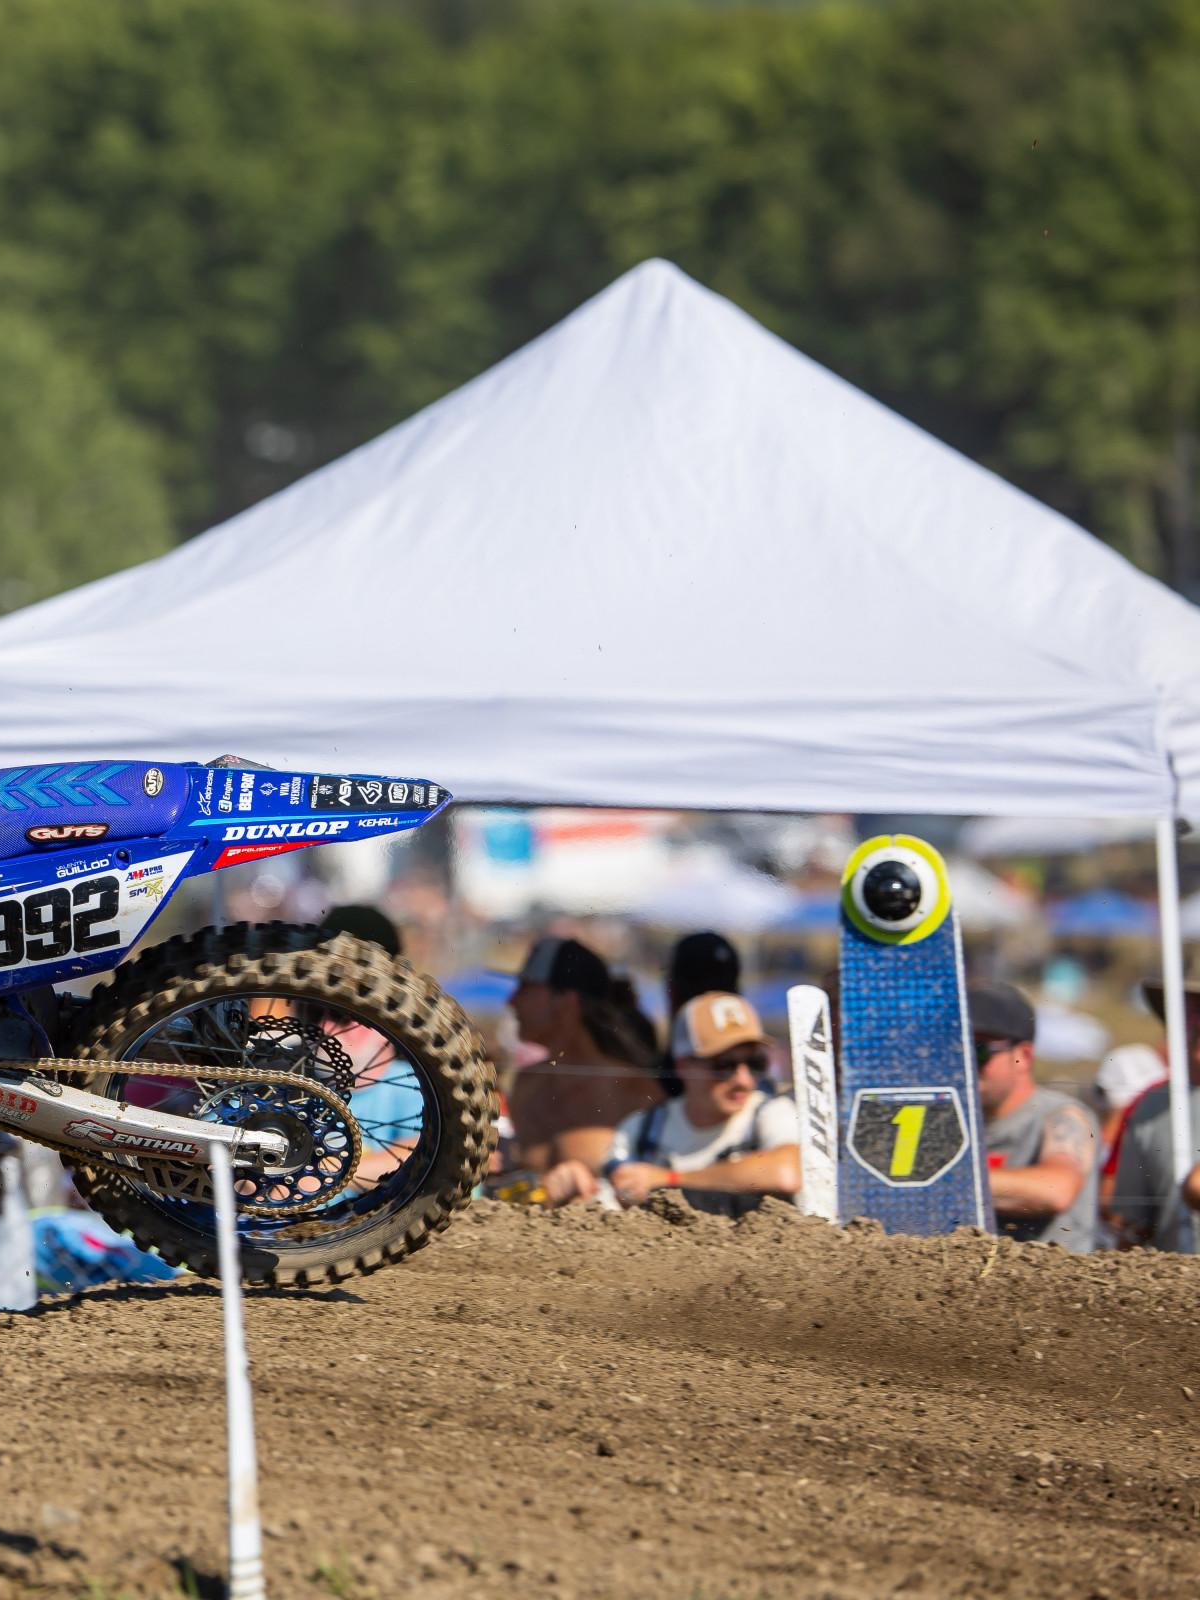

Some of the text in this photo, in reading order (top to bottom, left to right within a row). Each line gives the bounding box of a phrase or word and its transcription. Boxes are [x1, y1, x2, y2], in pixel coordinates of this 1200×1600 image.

[146, 770, 159, 795] GUTS
[205, 769, 214, 800] alpinestars
[279, 782, 290, 796] VIKA
[289, 776, 302, 805] SVENSSON
[310, 775, 320, 809] REKLUSE
[338, 778, 352, 806] ASV
[29, 824, 108, 841] GUTS
[222, 820, 350, 841] DUNLOP
[241, 844, 283, 853] POLISPORT
[55, 859, 86, 871] VALENTIN
[56, 859, 110, 878] GUILLOD
[125, 864, 163, 882] AMA PRO
[129, 880, 162, 898] SMX
[890, 1105, 927, 1176] 1
